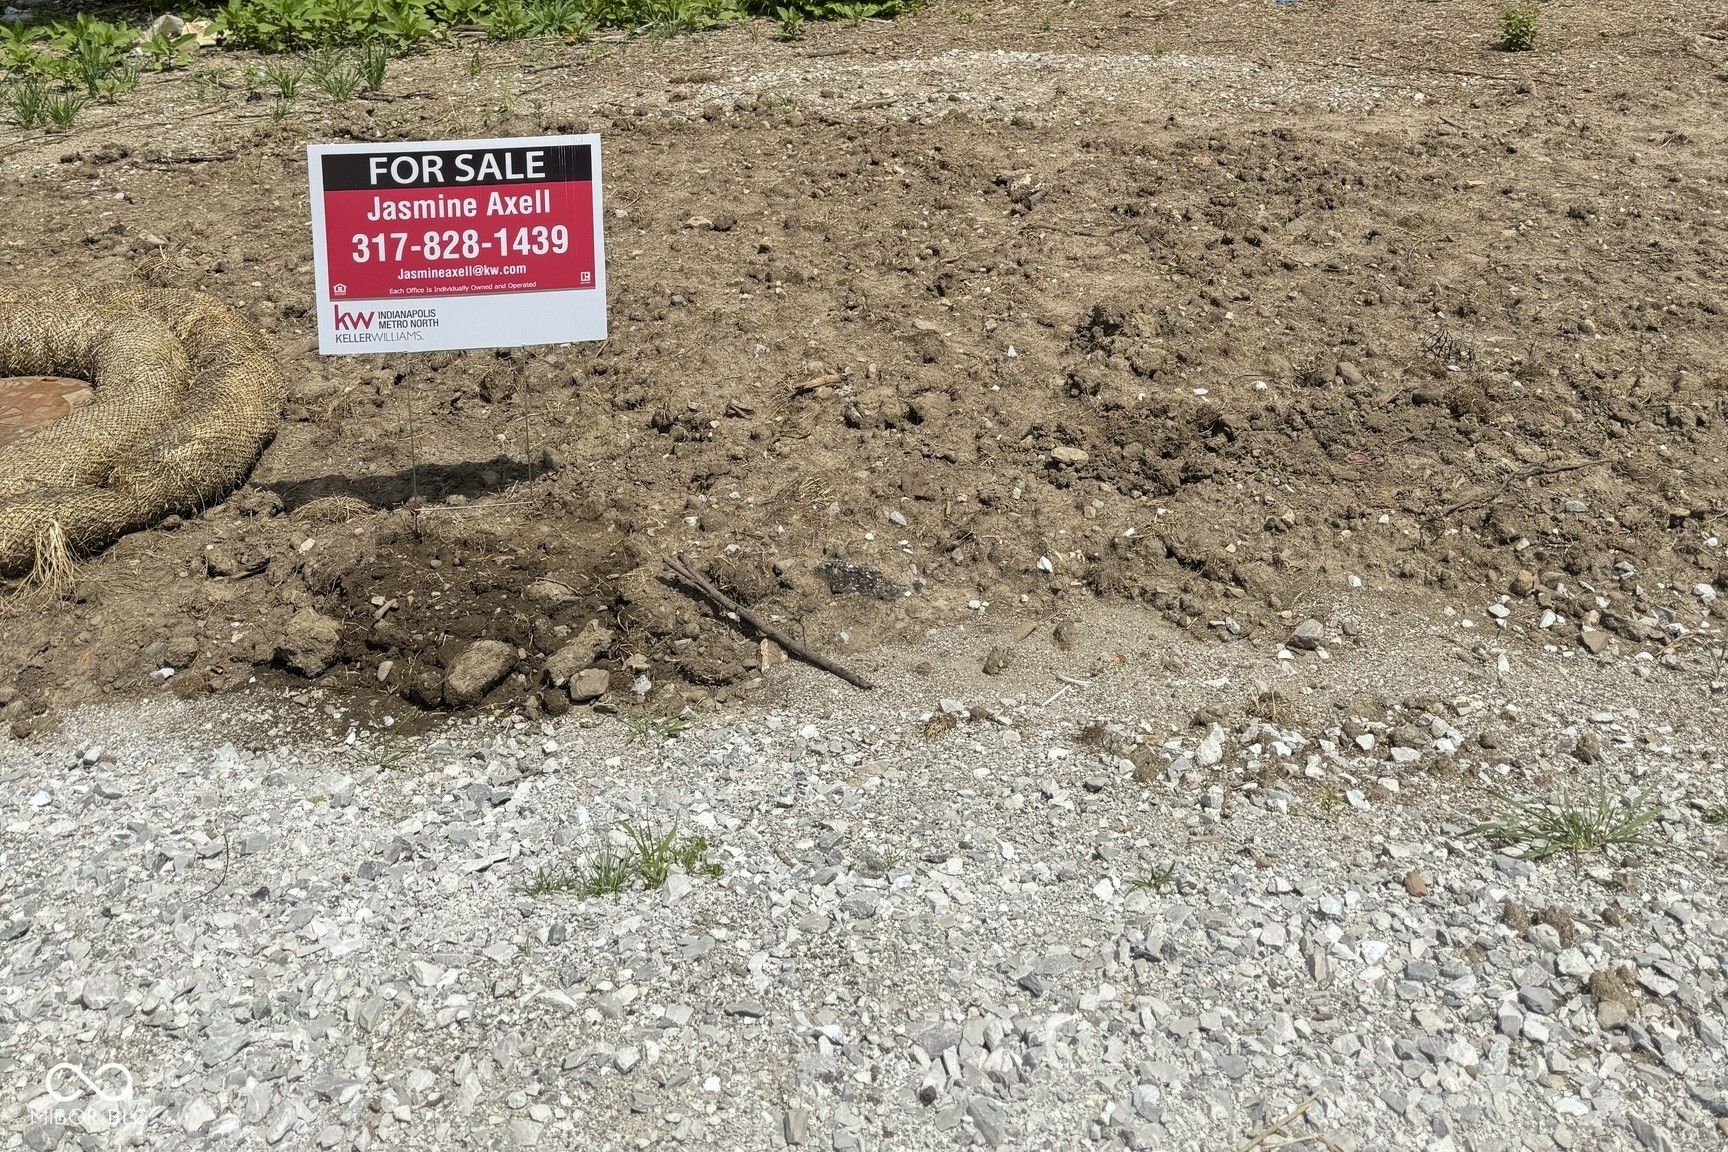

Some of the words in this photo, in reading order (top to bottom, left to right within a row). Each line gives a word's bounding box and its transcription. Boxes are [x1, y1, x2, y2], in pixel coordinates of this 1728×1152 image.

[369, 155, 445, 185] FOR
[454, 150, 546, 182] SALE
[367, 193, 477, 222] Jasmine
[486, 188, 550, 217] Axell
[351, 224, 569, 263] 317-828-1439
[397, 264, 527, 280] Jasmineaxell@kw.com
[433, 284, 469, 294] Individually
[470, 283, 493, 291] Owned
[508, 281, 537, 290] Operated
[334, 304, 375, 330] kw
[378, 309, 437, 320] INDIANAPOLIS
[378, 319, 409, 329] METRO
[410, 318, 439, 328] NORTH
